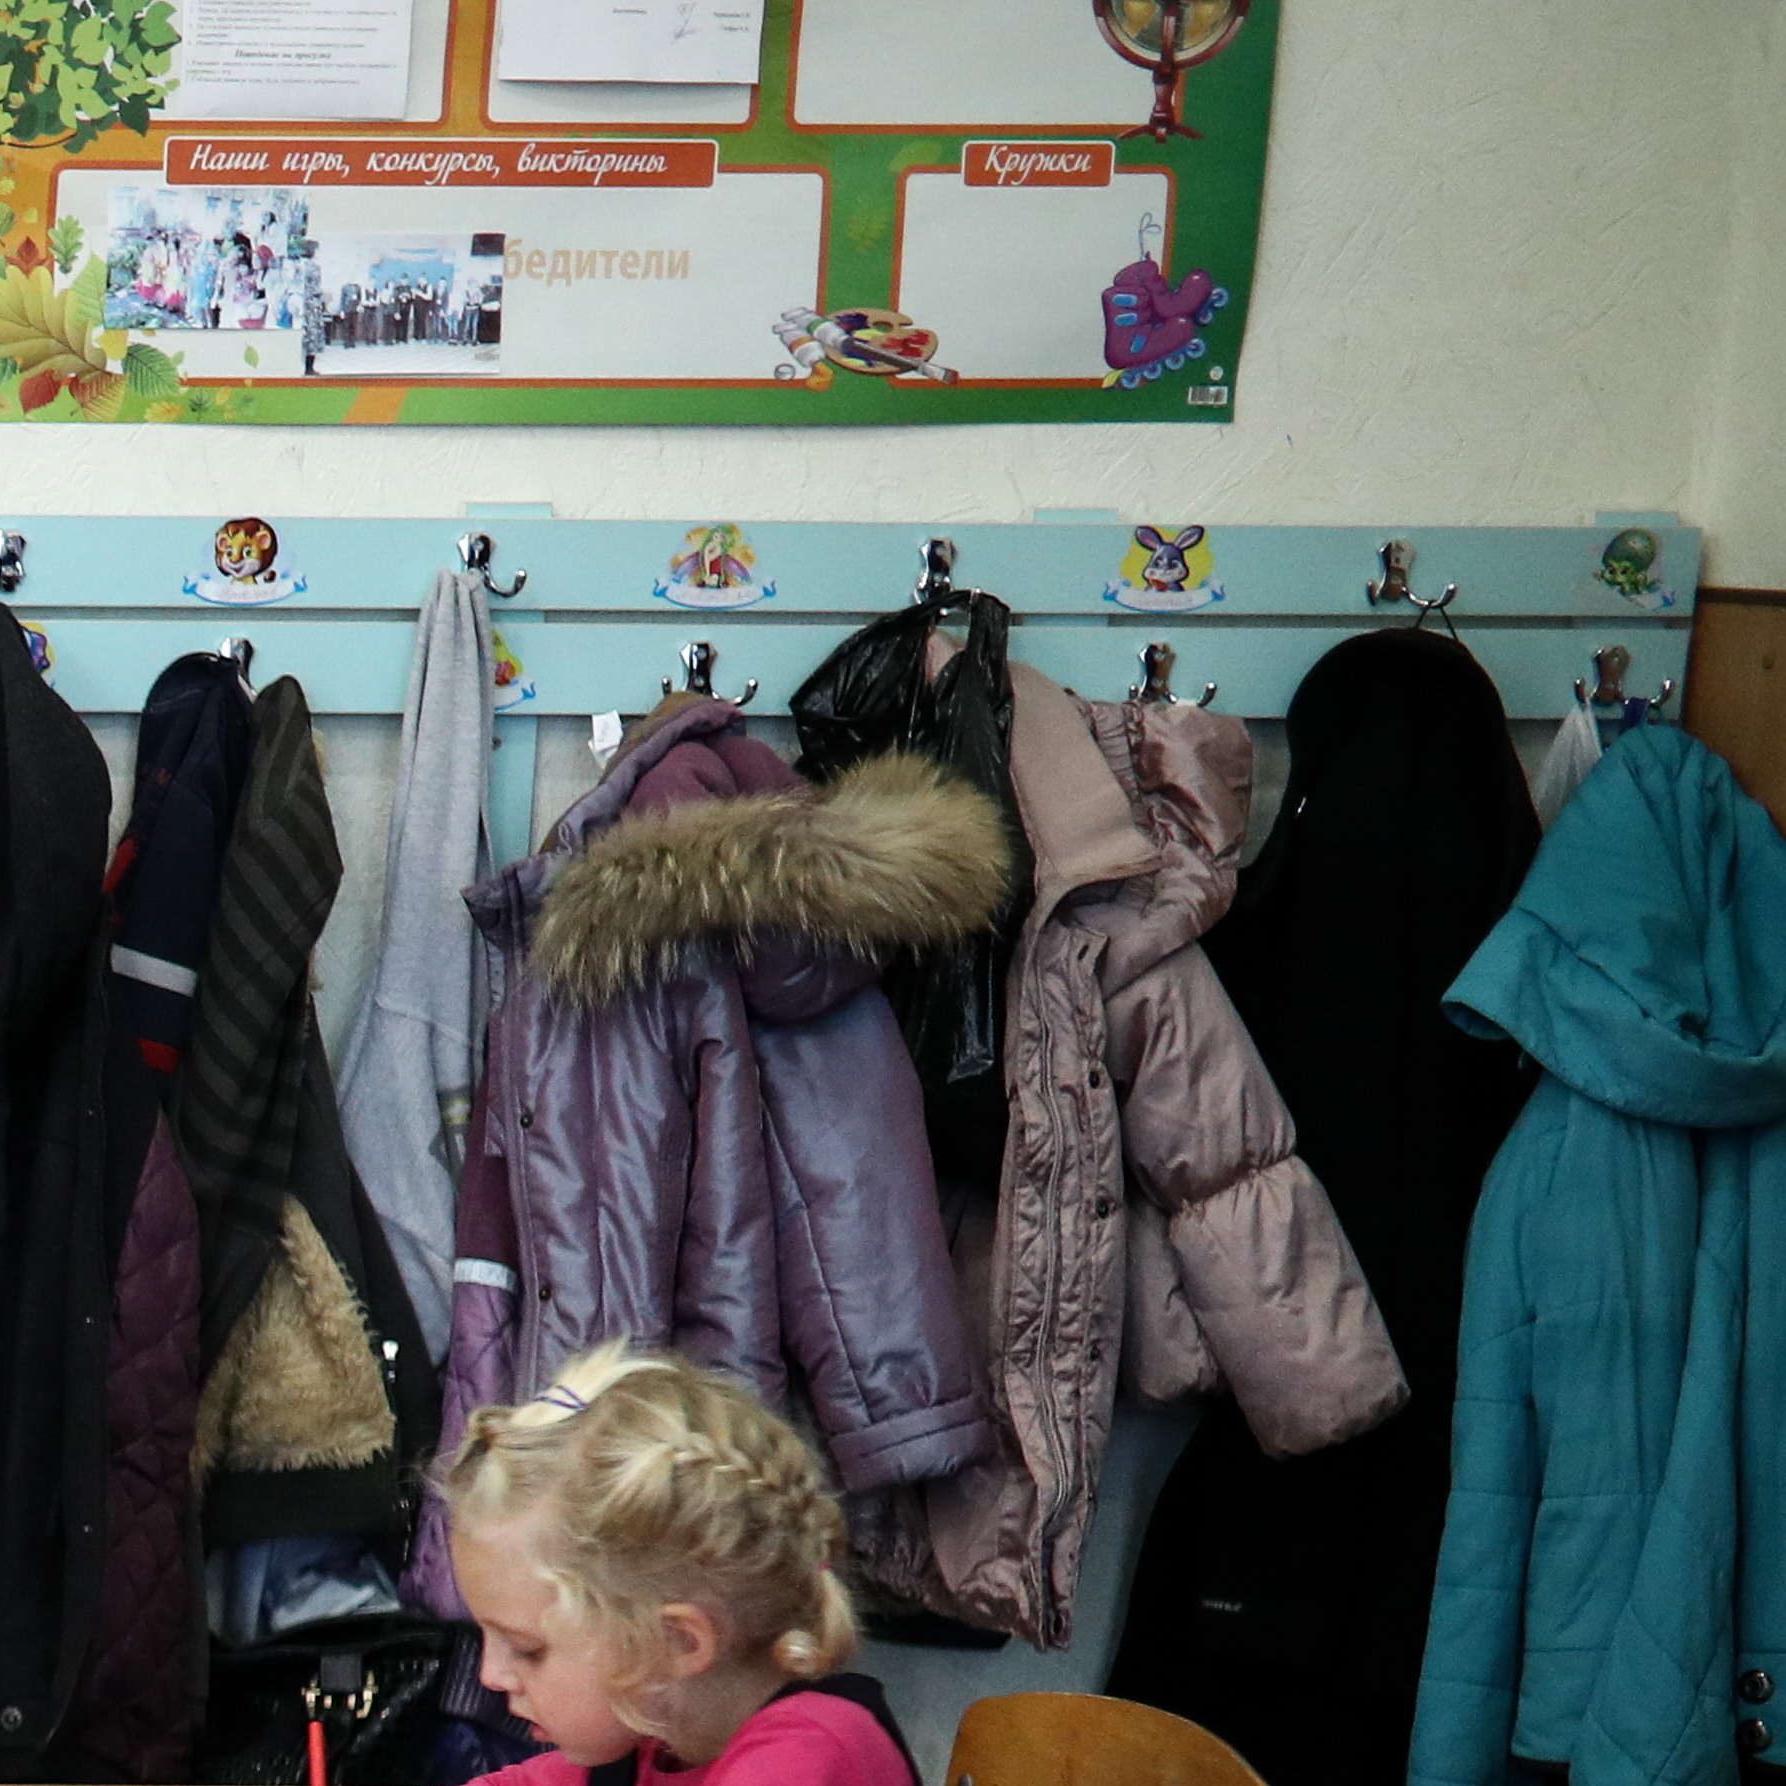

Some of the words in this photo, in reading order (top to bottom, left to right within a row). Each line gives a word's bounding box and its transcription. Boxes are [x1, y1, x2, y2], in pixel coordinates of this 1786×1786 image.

[189, 142, 270, 172] Наши
[282, 149, 352, 182] игры,
[365, 150, 501, 185] конкурсы,
[516, 142, 668, 185] викторины
[984, 144, 1092, 185] Кружки
[502, 237, 691, 288] бедители
